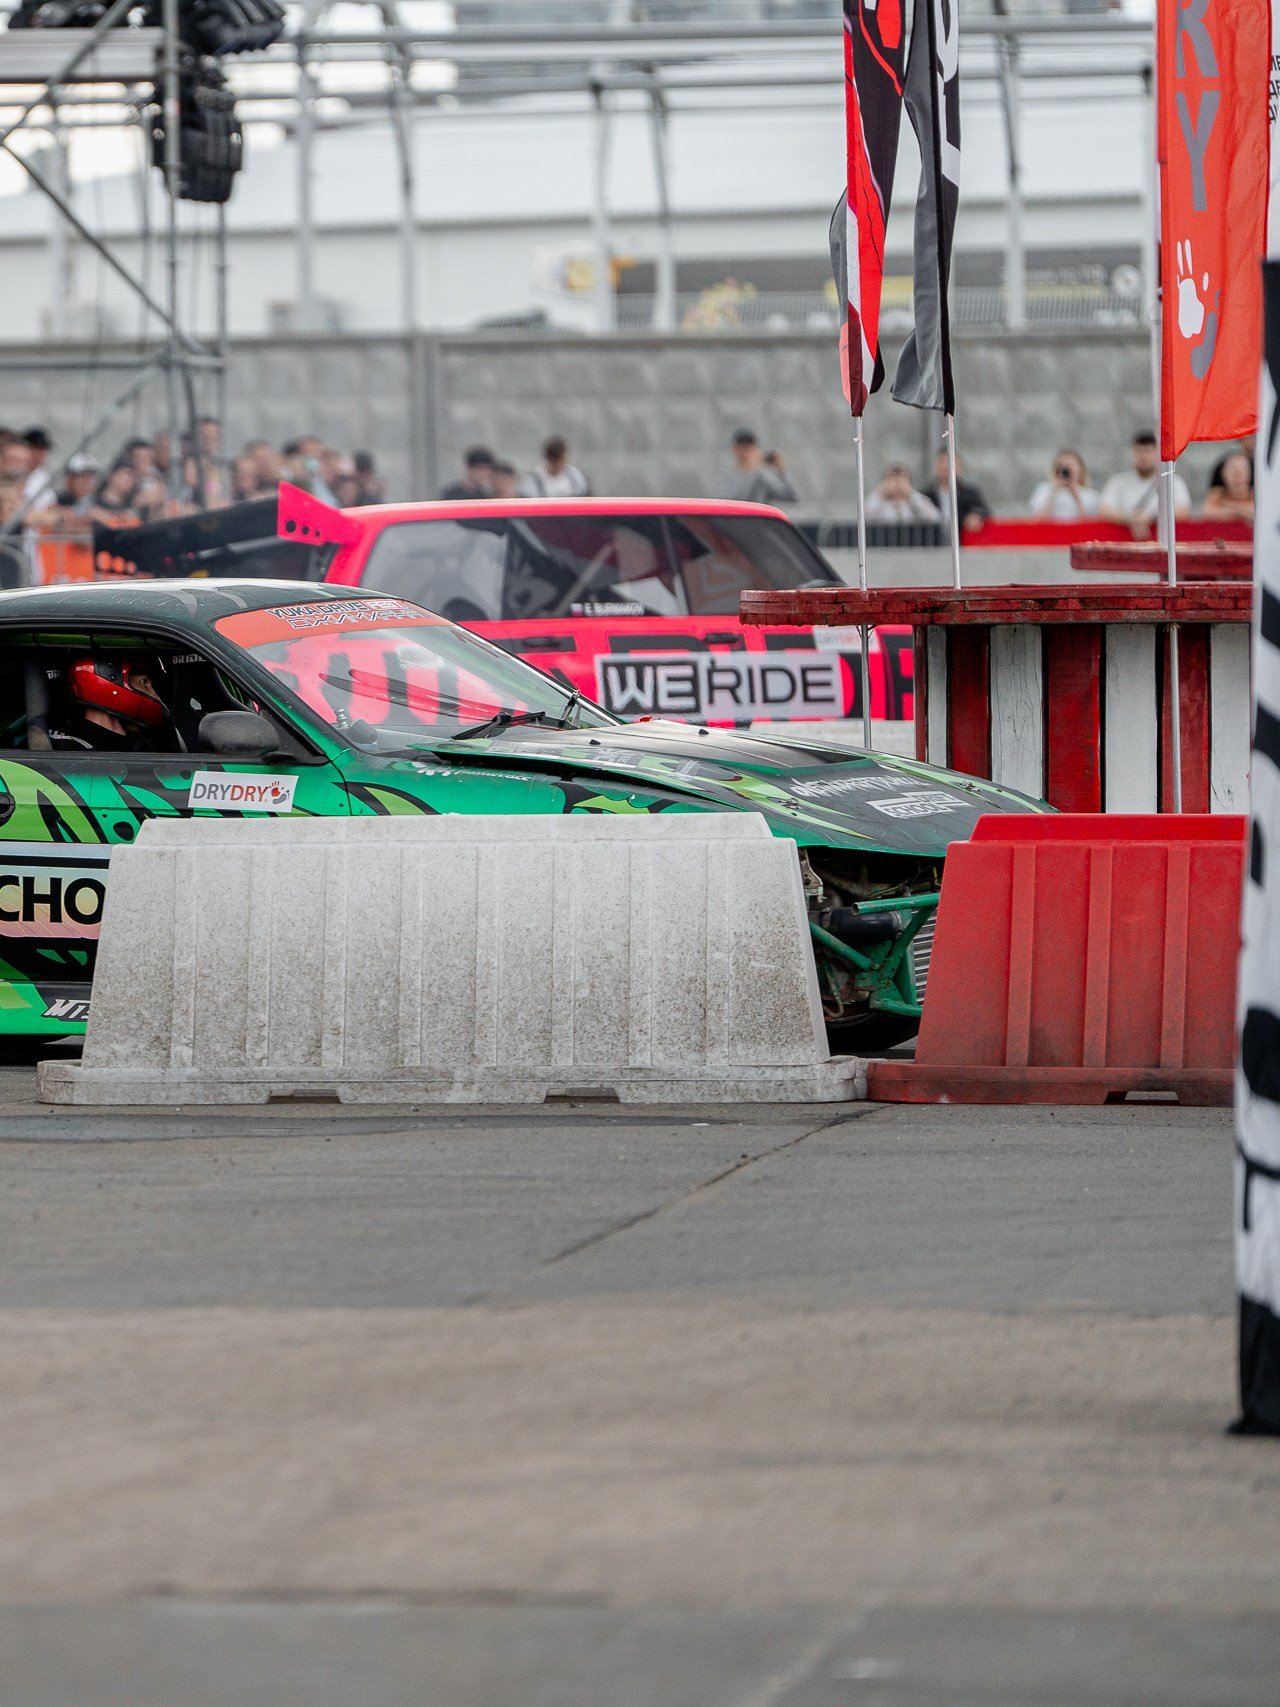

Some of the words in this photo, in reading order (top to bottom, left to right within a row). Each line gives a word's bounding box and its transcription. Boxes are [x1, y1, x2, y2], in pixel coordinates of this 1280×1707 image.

[266, 604, 317, 619] YUKA
[317, 601, 368, 615] DRIVE
[193, 783, 269, 802] DRYDRY
